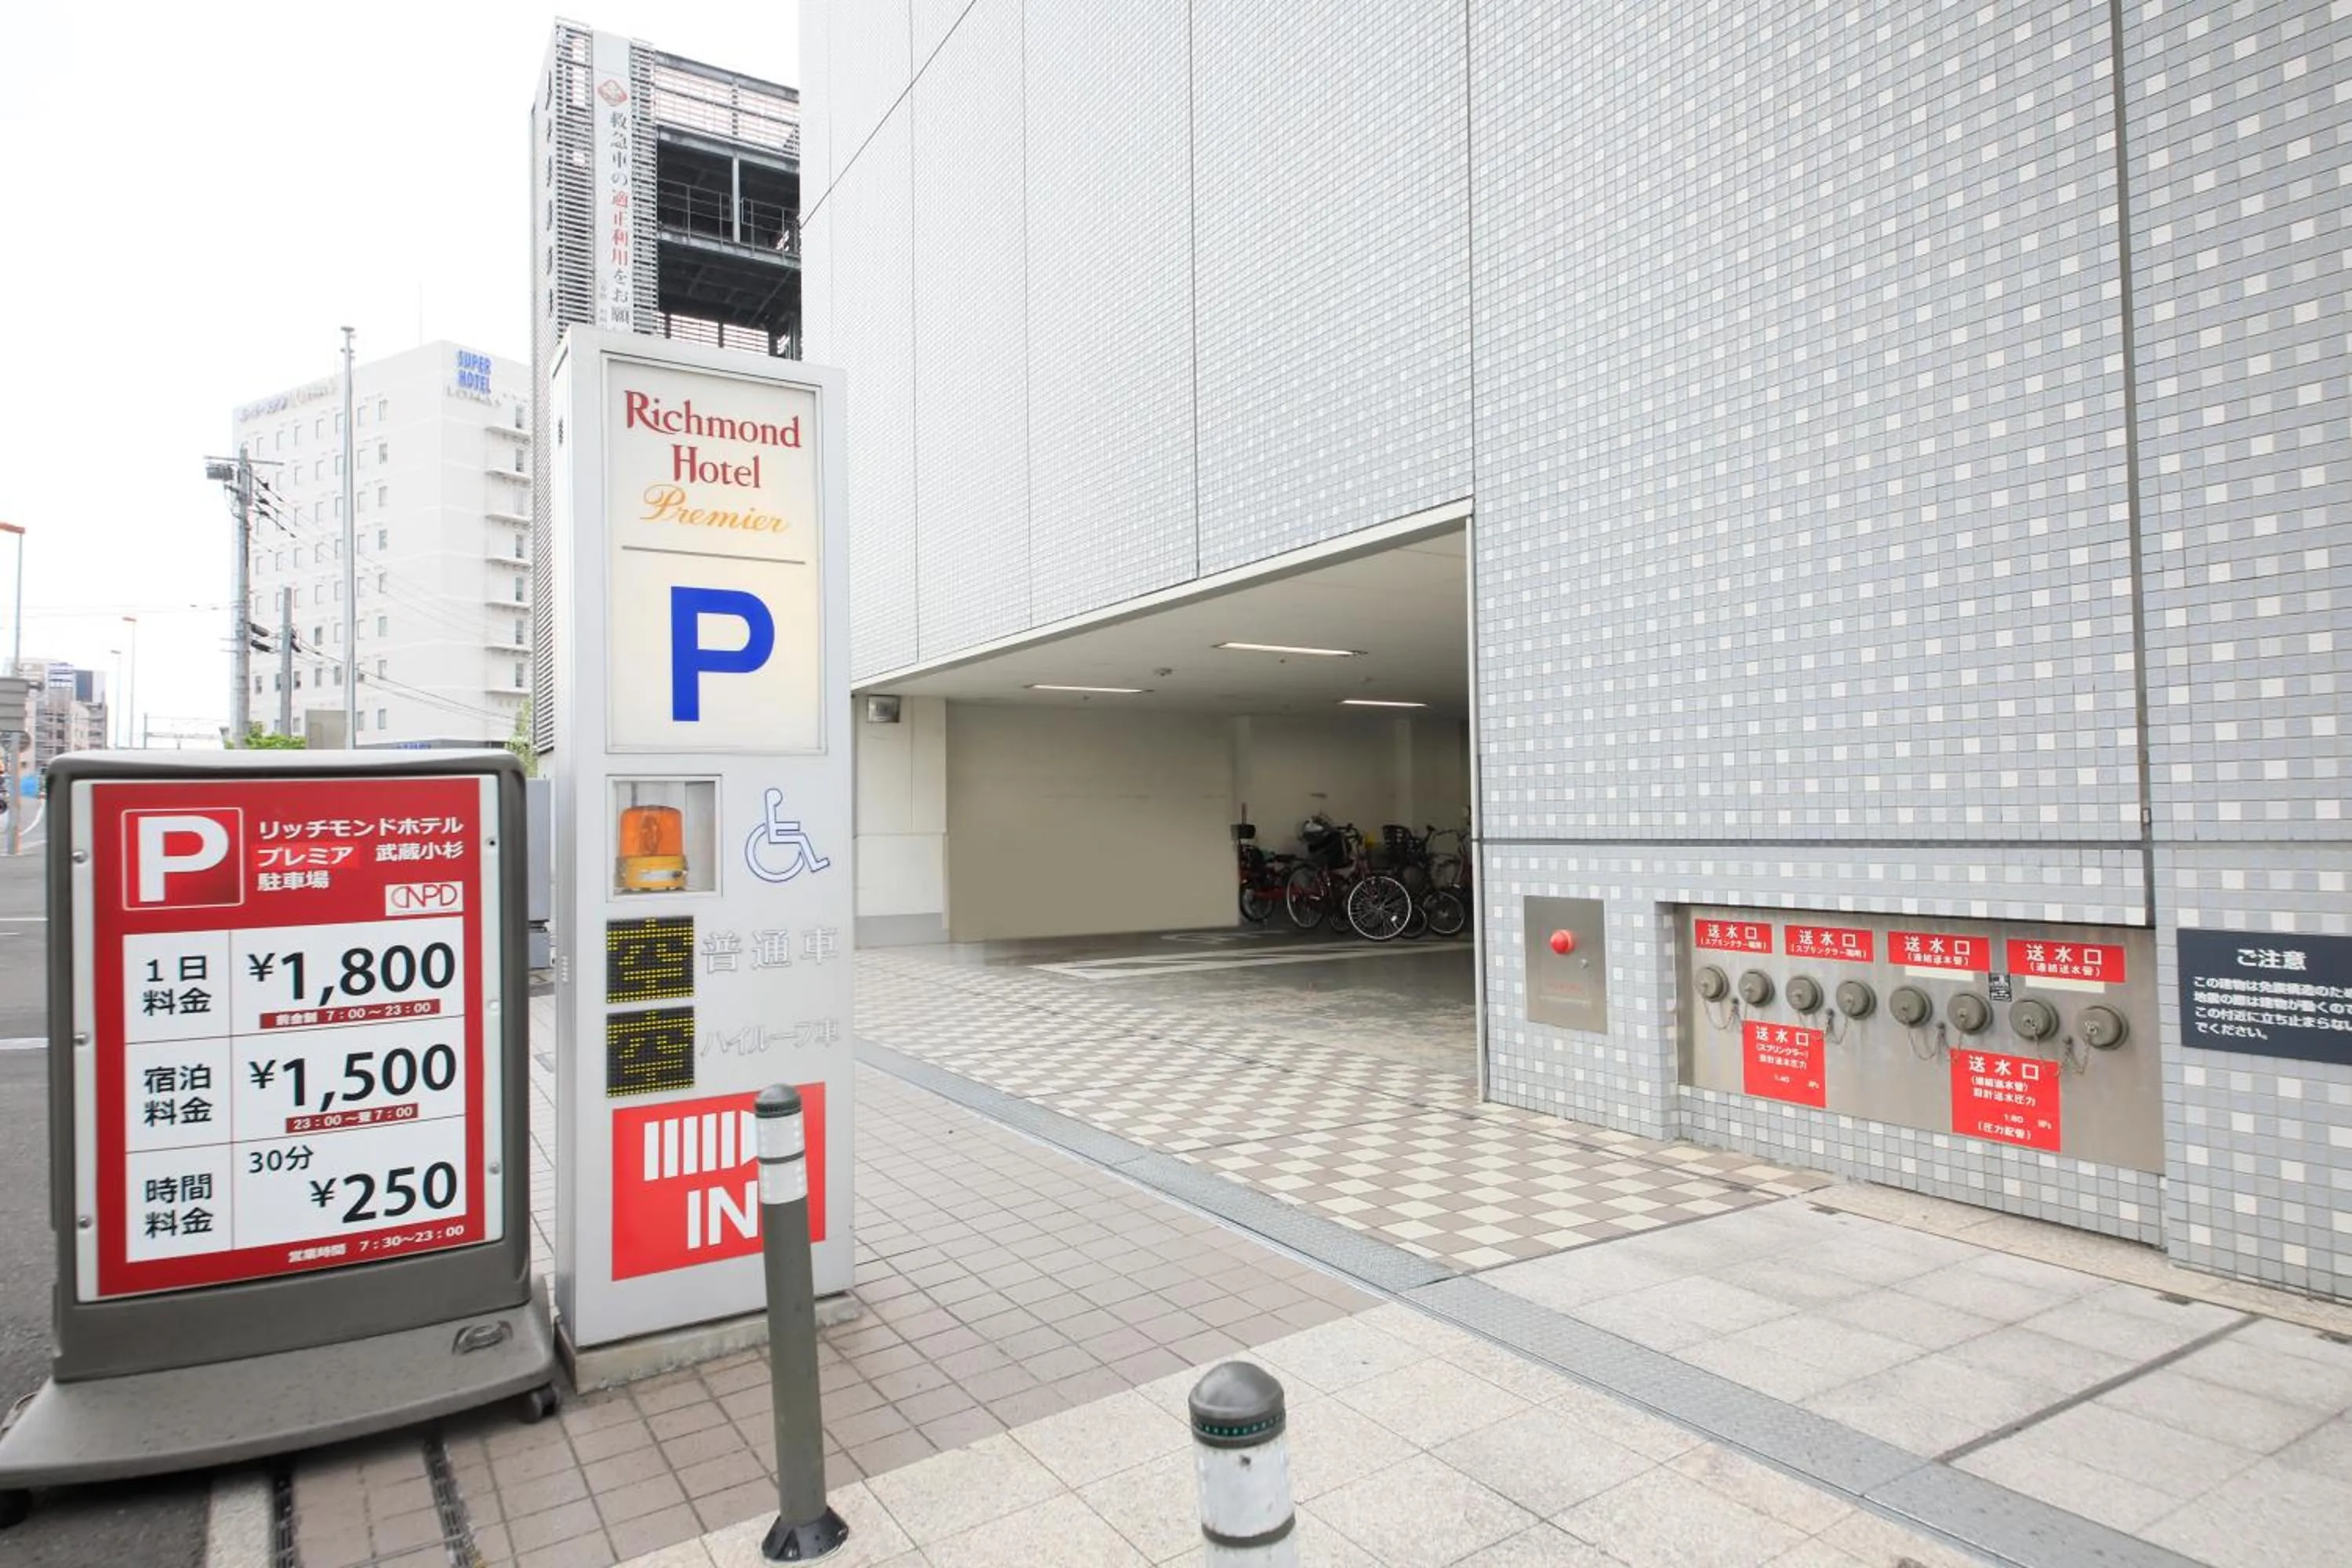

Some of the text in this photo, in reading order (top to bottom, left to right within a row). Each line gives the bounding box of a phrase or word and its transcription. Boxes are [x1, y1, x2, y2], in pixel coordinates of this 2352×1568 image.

[458, 350, 492, 375] SUPER
[458, 368, 492, 394] HOTEL
[624, 390, 802, 448] Richmond
[671, 444, 761, 489] Hotel
[639, 483, 789, 534] Premier
[670, 585, 775, 722] P
[259, 816, 465, 840] リッチモンドホテル
[137, 815, 230, 903] P
[257, 840, 464, 867] プレミア 武蔵小杉
[256, 869, 331, 892] 駐車場
[1708, 923, 1758, 941] 送水口
[1798, 929, 1857, 949] 送水口
[1904, 935, 1971, 956] 送水口
[607, 917, 695, 1004] 空
[701, 927, 839, 975] 普通車
[2025, 943, 2103, 965] 送水口
[2236, 948, 2307, 971] ご注意
[142, 986, 212, 1017] 料金
[699, 1018, 840, 1058] ハイルーフ車
[1756, 1025, 1809, 1047] 送水口
[607, 1009, 695, 1098] 空
[1969, 1054, 2040, 1081] 送水口
[143, 1064, 212, 1094] 宿泊
[143, 1097, 212, 1127] 料金
[249, 1144, 314, 1174] 30分
[144, 1173, 212, 1204] 時間
[144, 1206, 214, 1239] 料金
[687, 1179, 759, 1250] IN
